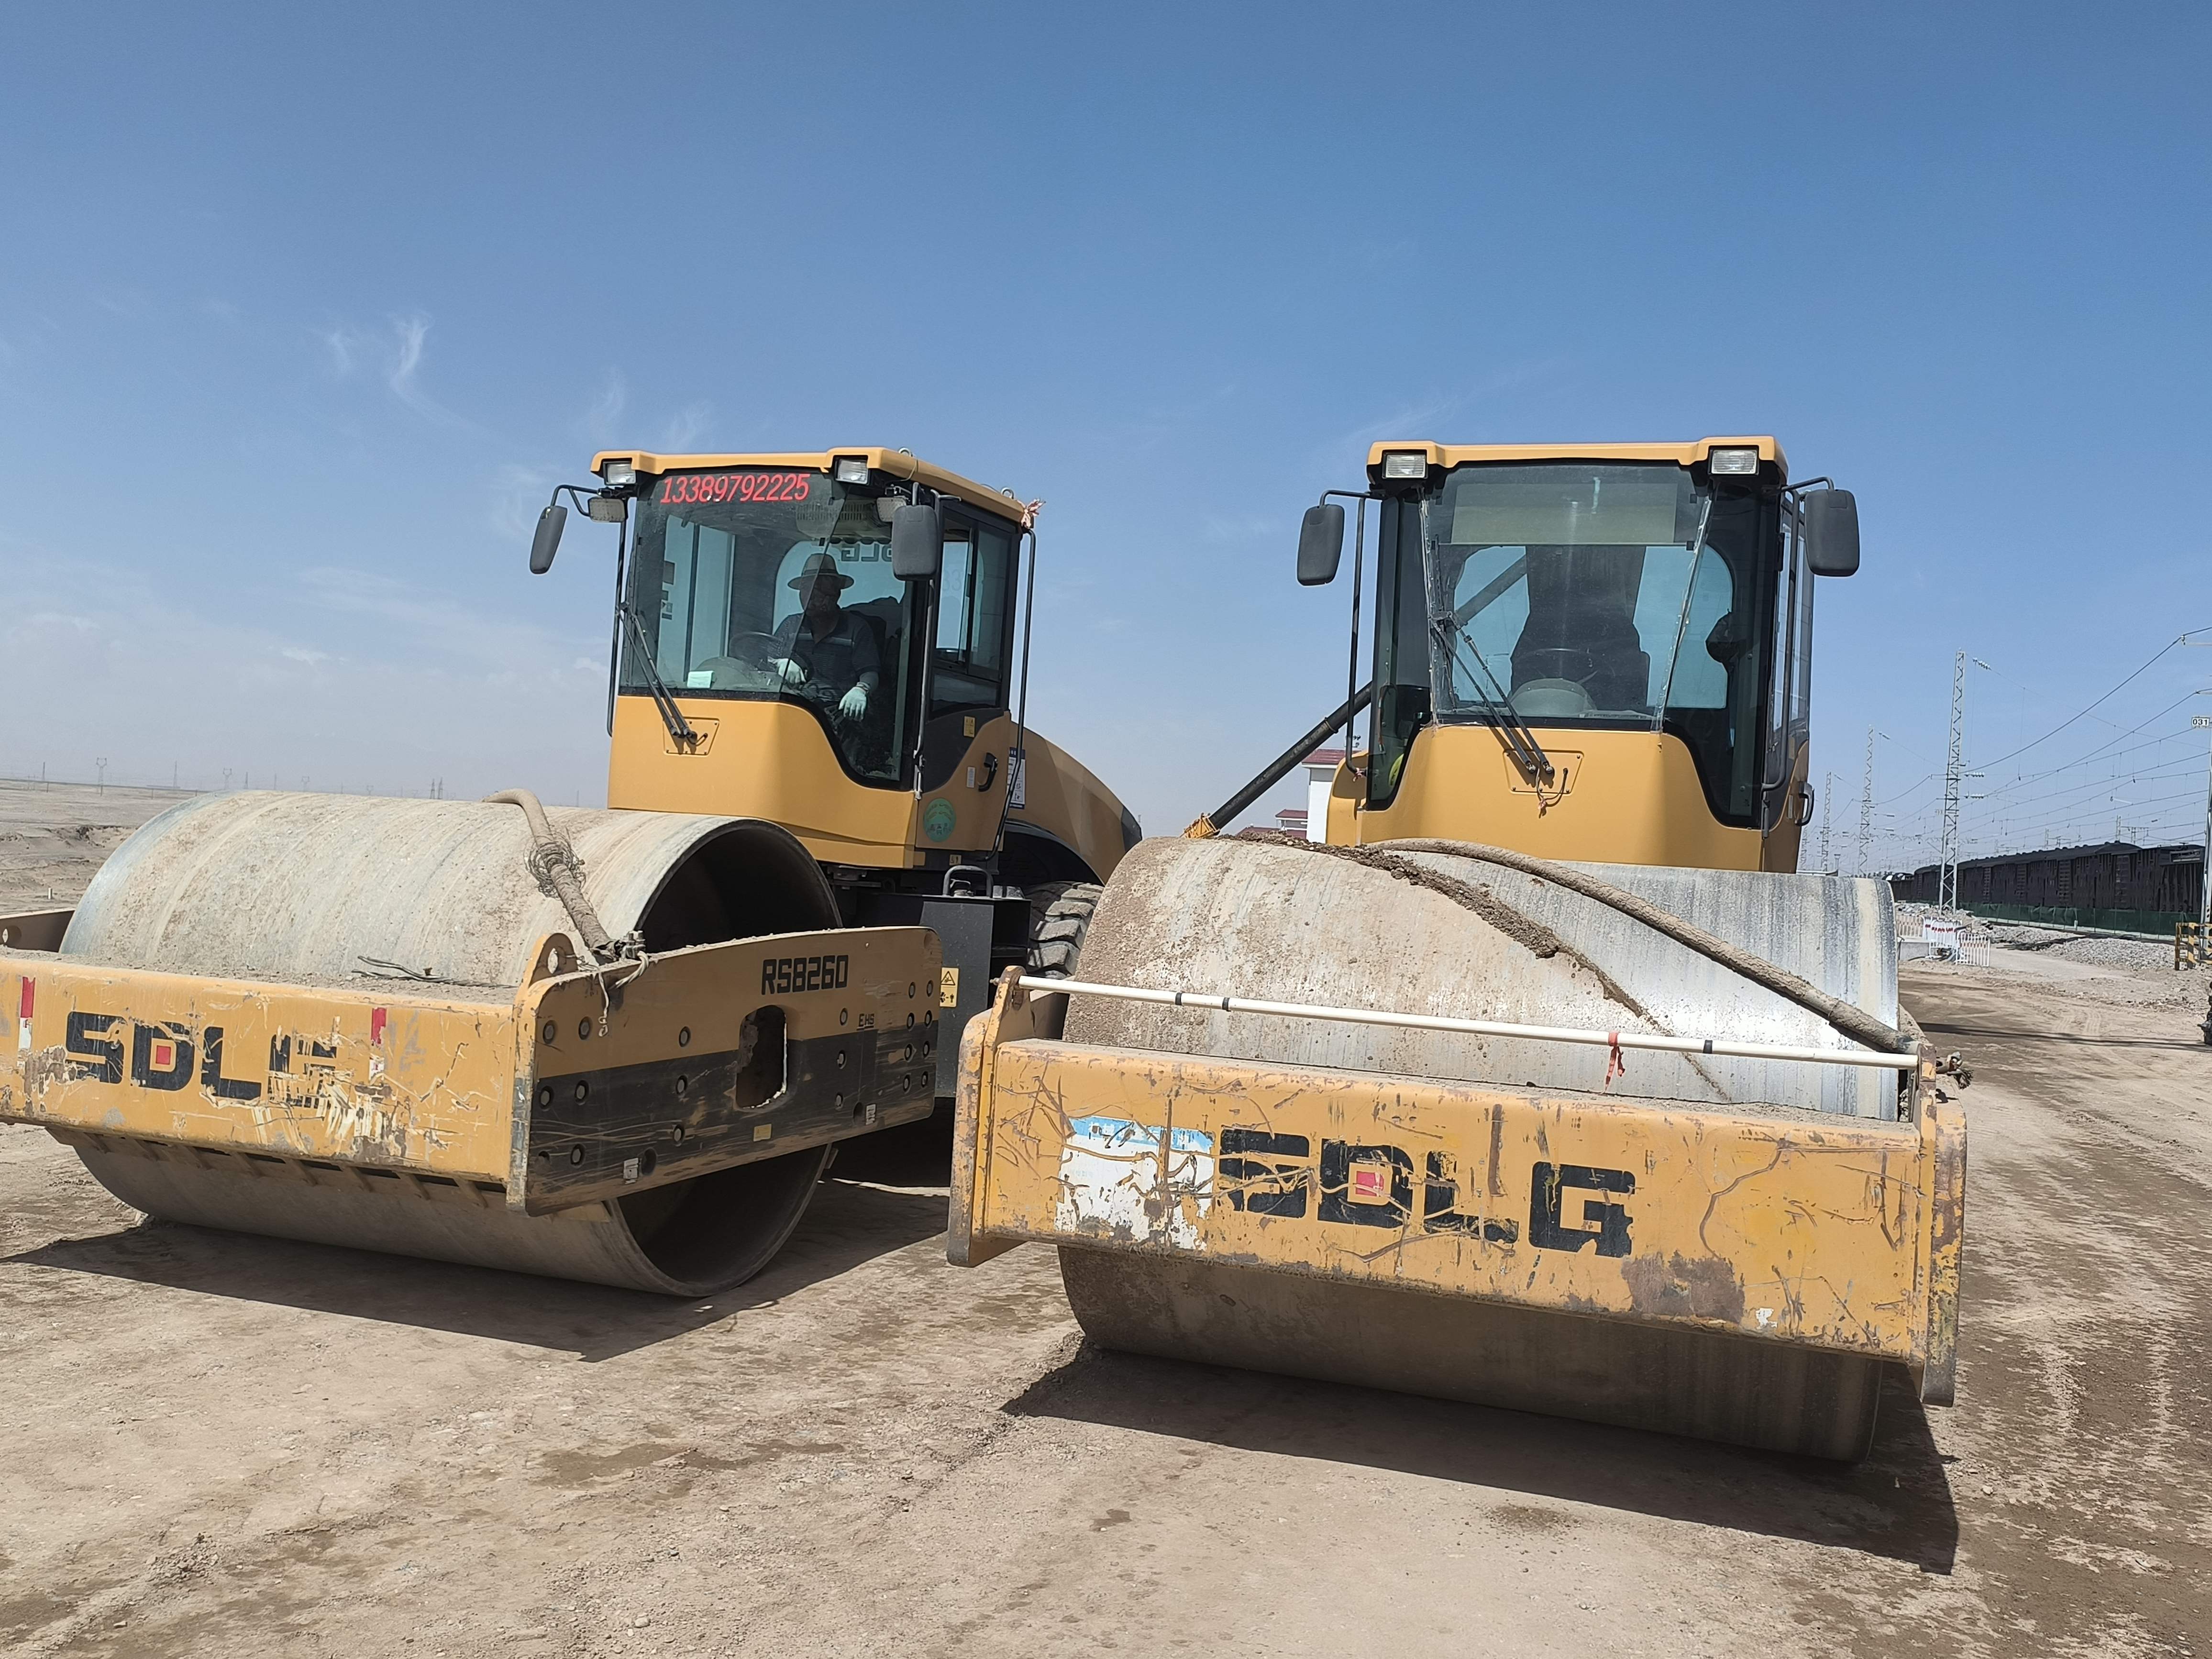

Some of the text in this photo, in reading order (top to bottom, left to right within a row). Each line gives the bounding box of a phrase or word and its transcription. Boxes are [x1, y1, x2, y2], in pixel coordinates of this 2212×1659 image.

[660, 473, 810, 504] 13389792225
[762, 955, 849, 995] RS8260
[1219, 1128, 1635, 1258] SDLG
